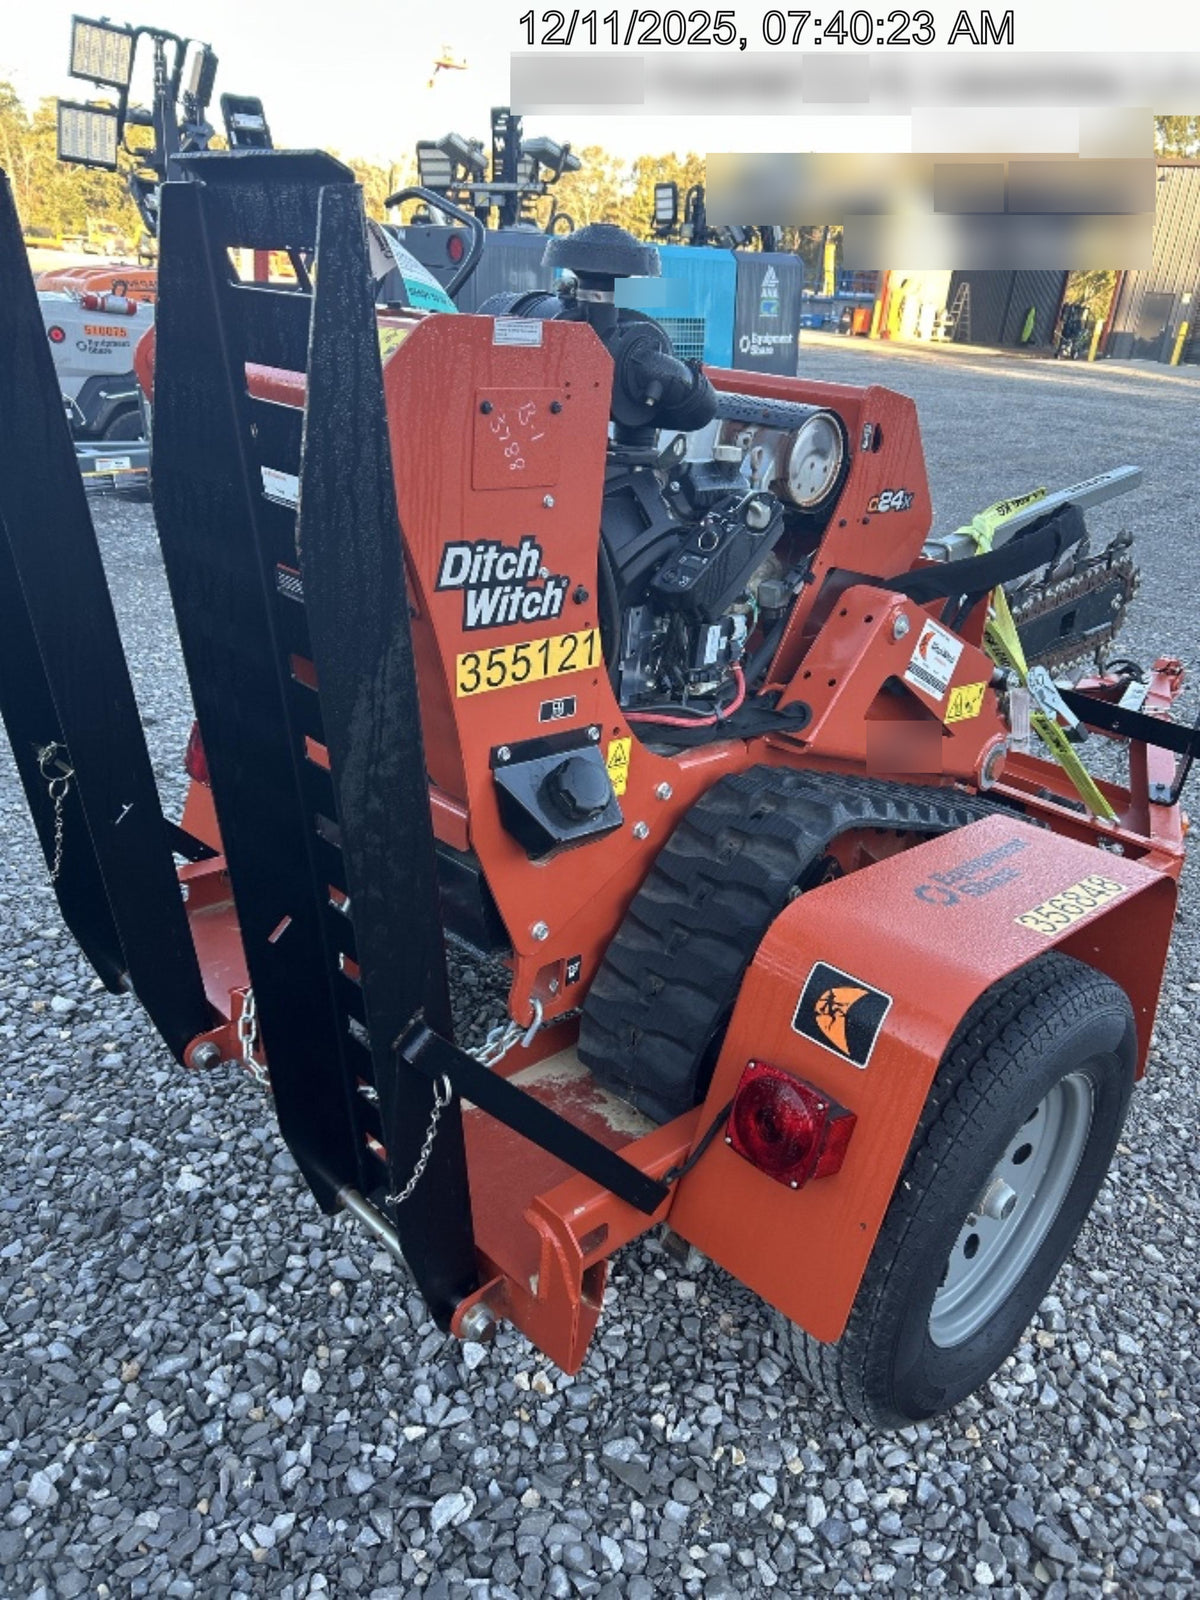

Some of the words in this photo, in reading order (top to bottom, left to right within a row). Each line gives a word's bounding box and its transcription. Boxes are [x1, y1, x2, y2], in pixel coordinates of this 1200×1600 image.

[437, 538, 541, 589] Ditch
[464, 579, 566, 628] Witch
[460, 630, 595, 693] 355121
[1018, 875, 1123, 934] 356848
